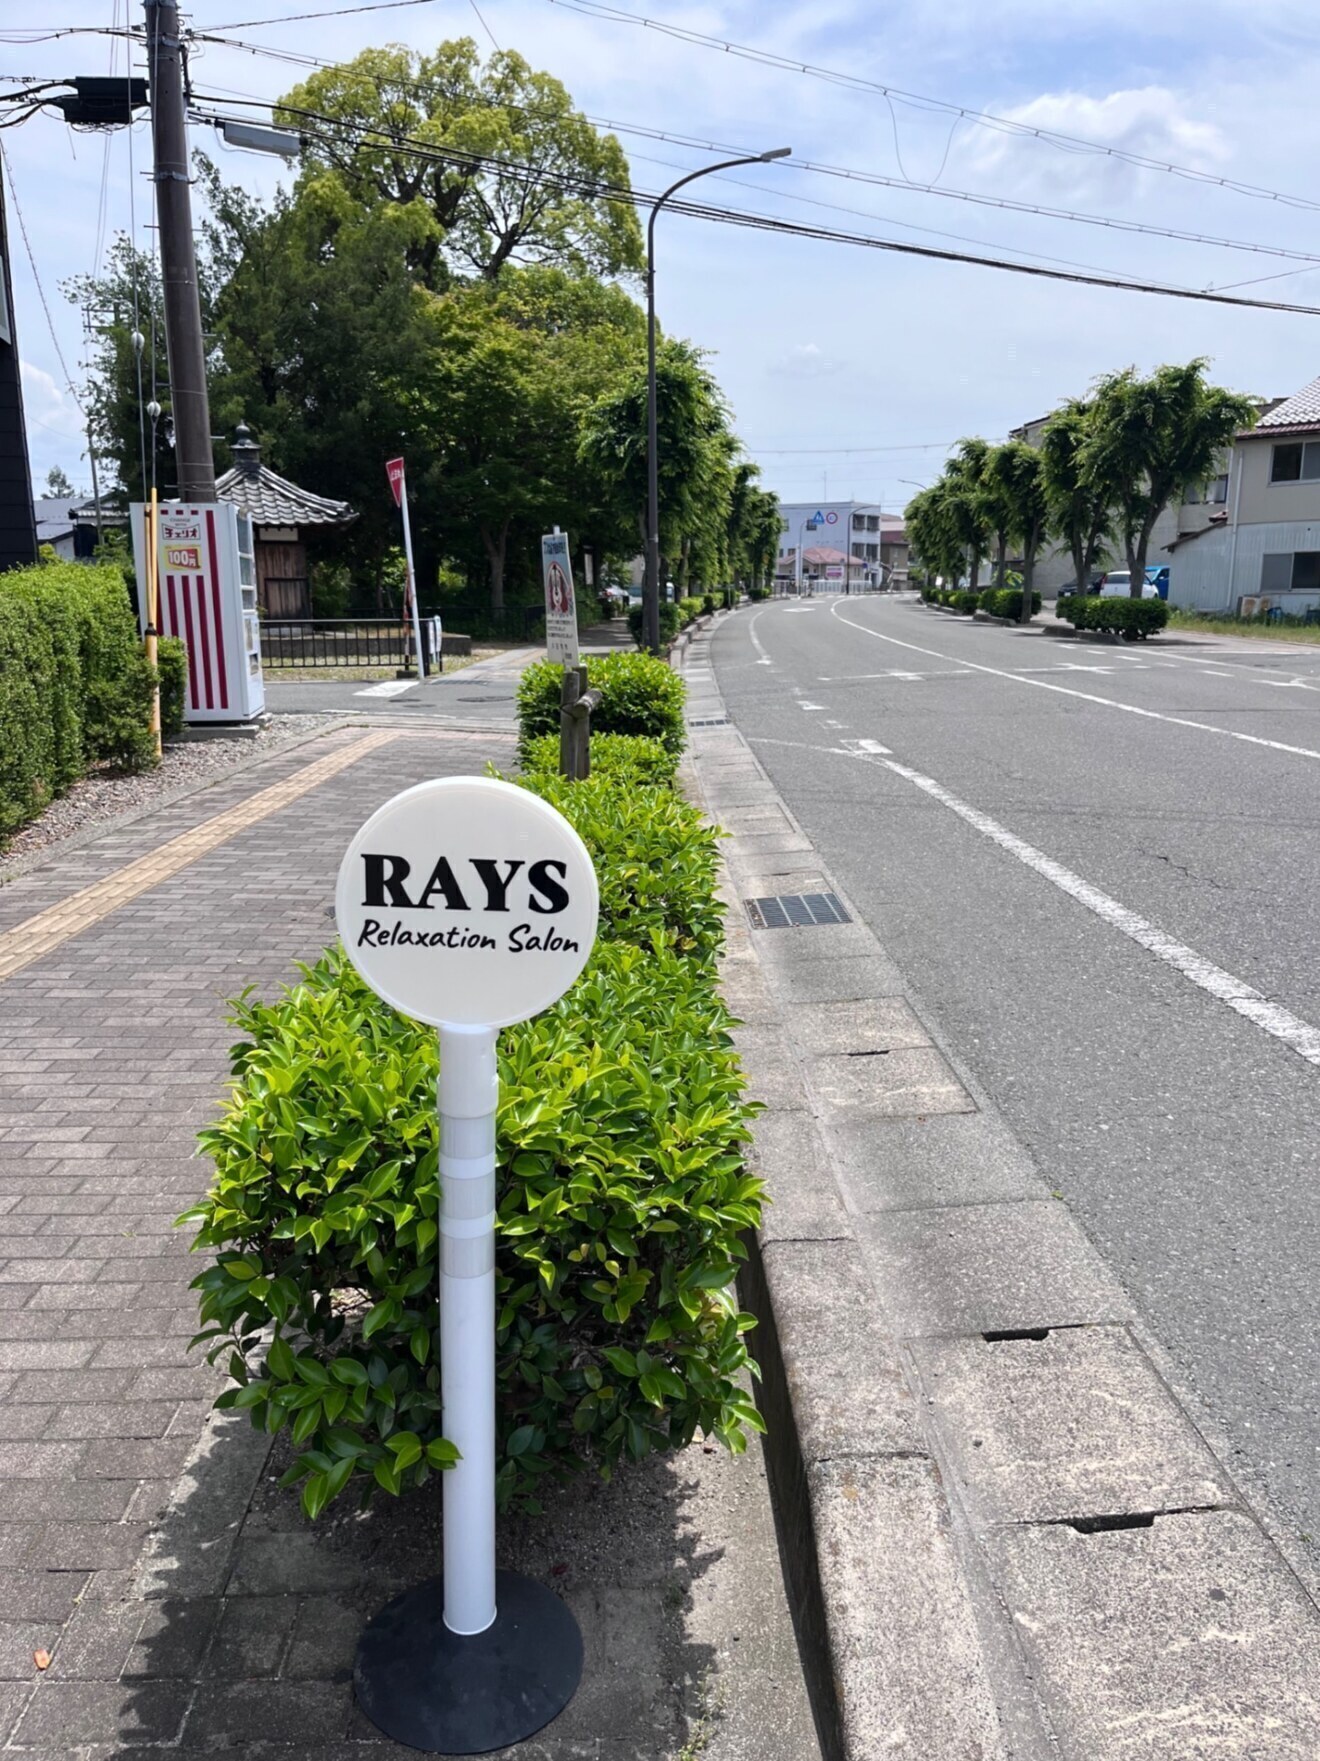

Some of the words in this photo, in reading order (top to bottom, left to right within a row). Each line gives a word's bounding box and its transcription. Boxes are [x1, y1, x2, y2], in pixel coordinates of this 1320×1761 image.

[165, 527, 197, 538] チェリオ
[360, 853, 570, 914] RAYS
[357, 918, 496, 949] Relaxation
[508, 923, 579, 953] Salon
